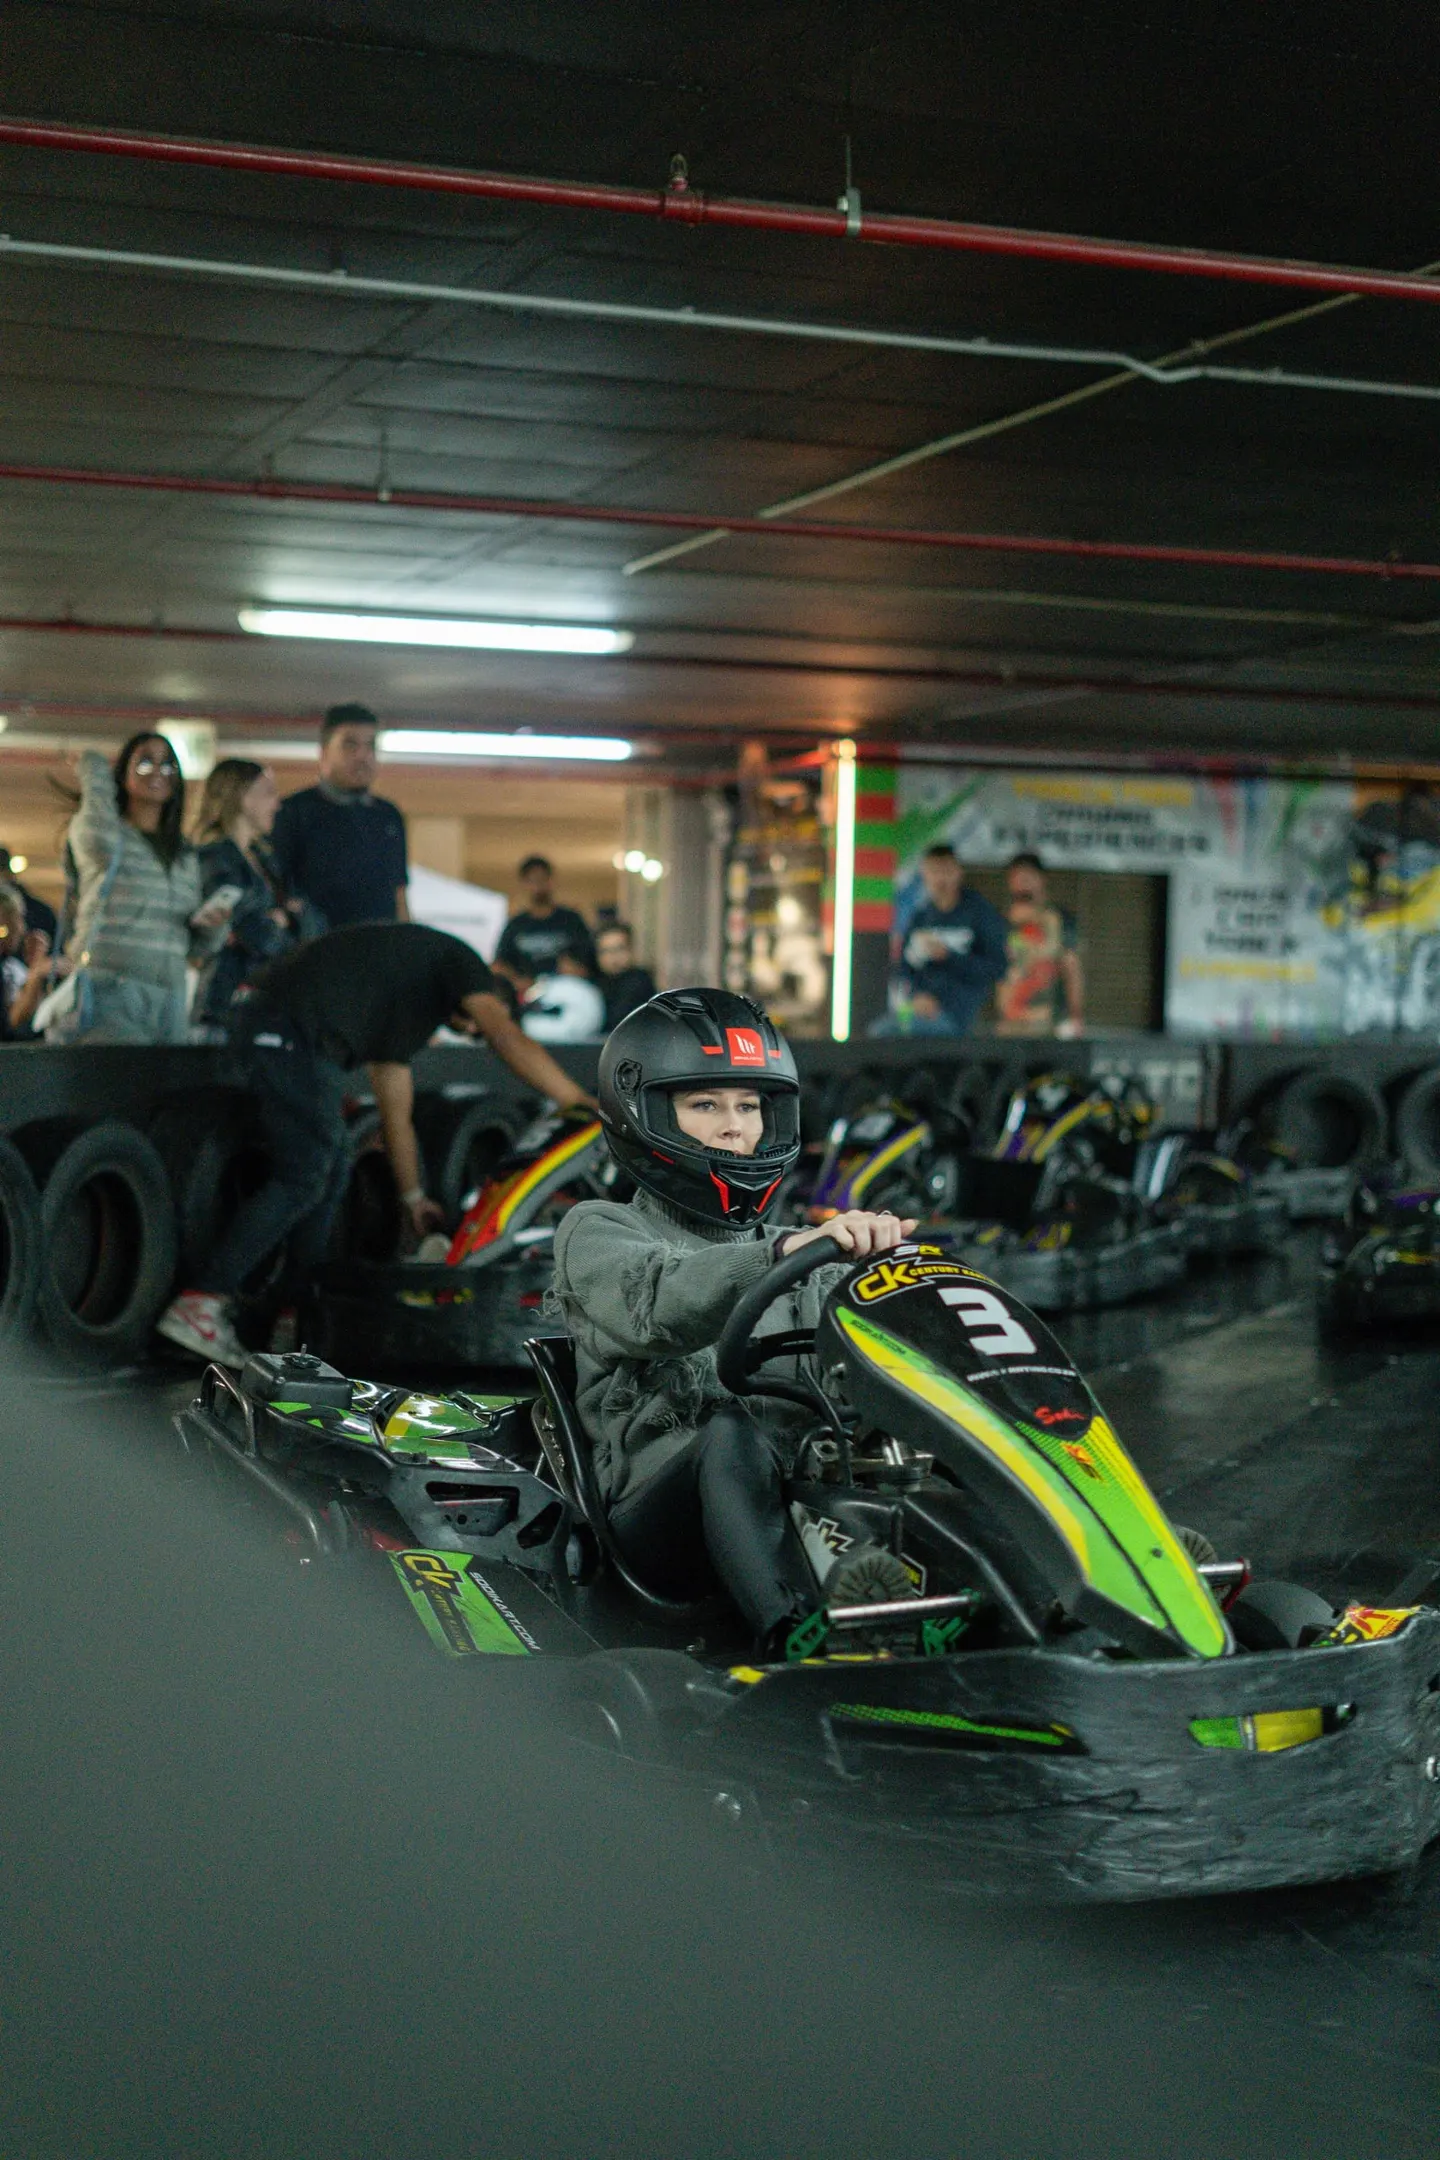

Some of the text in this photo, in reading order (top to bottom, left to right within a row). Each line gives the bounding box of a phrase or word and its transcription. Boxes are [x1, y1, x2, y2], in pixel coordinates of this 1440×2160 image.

[909, 1266, 960, 1276] CENTURY
[937, 1287, 1037, 1355] 3
[470, 1571, 541, 1651] SODIKART.COM
